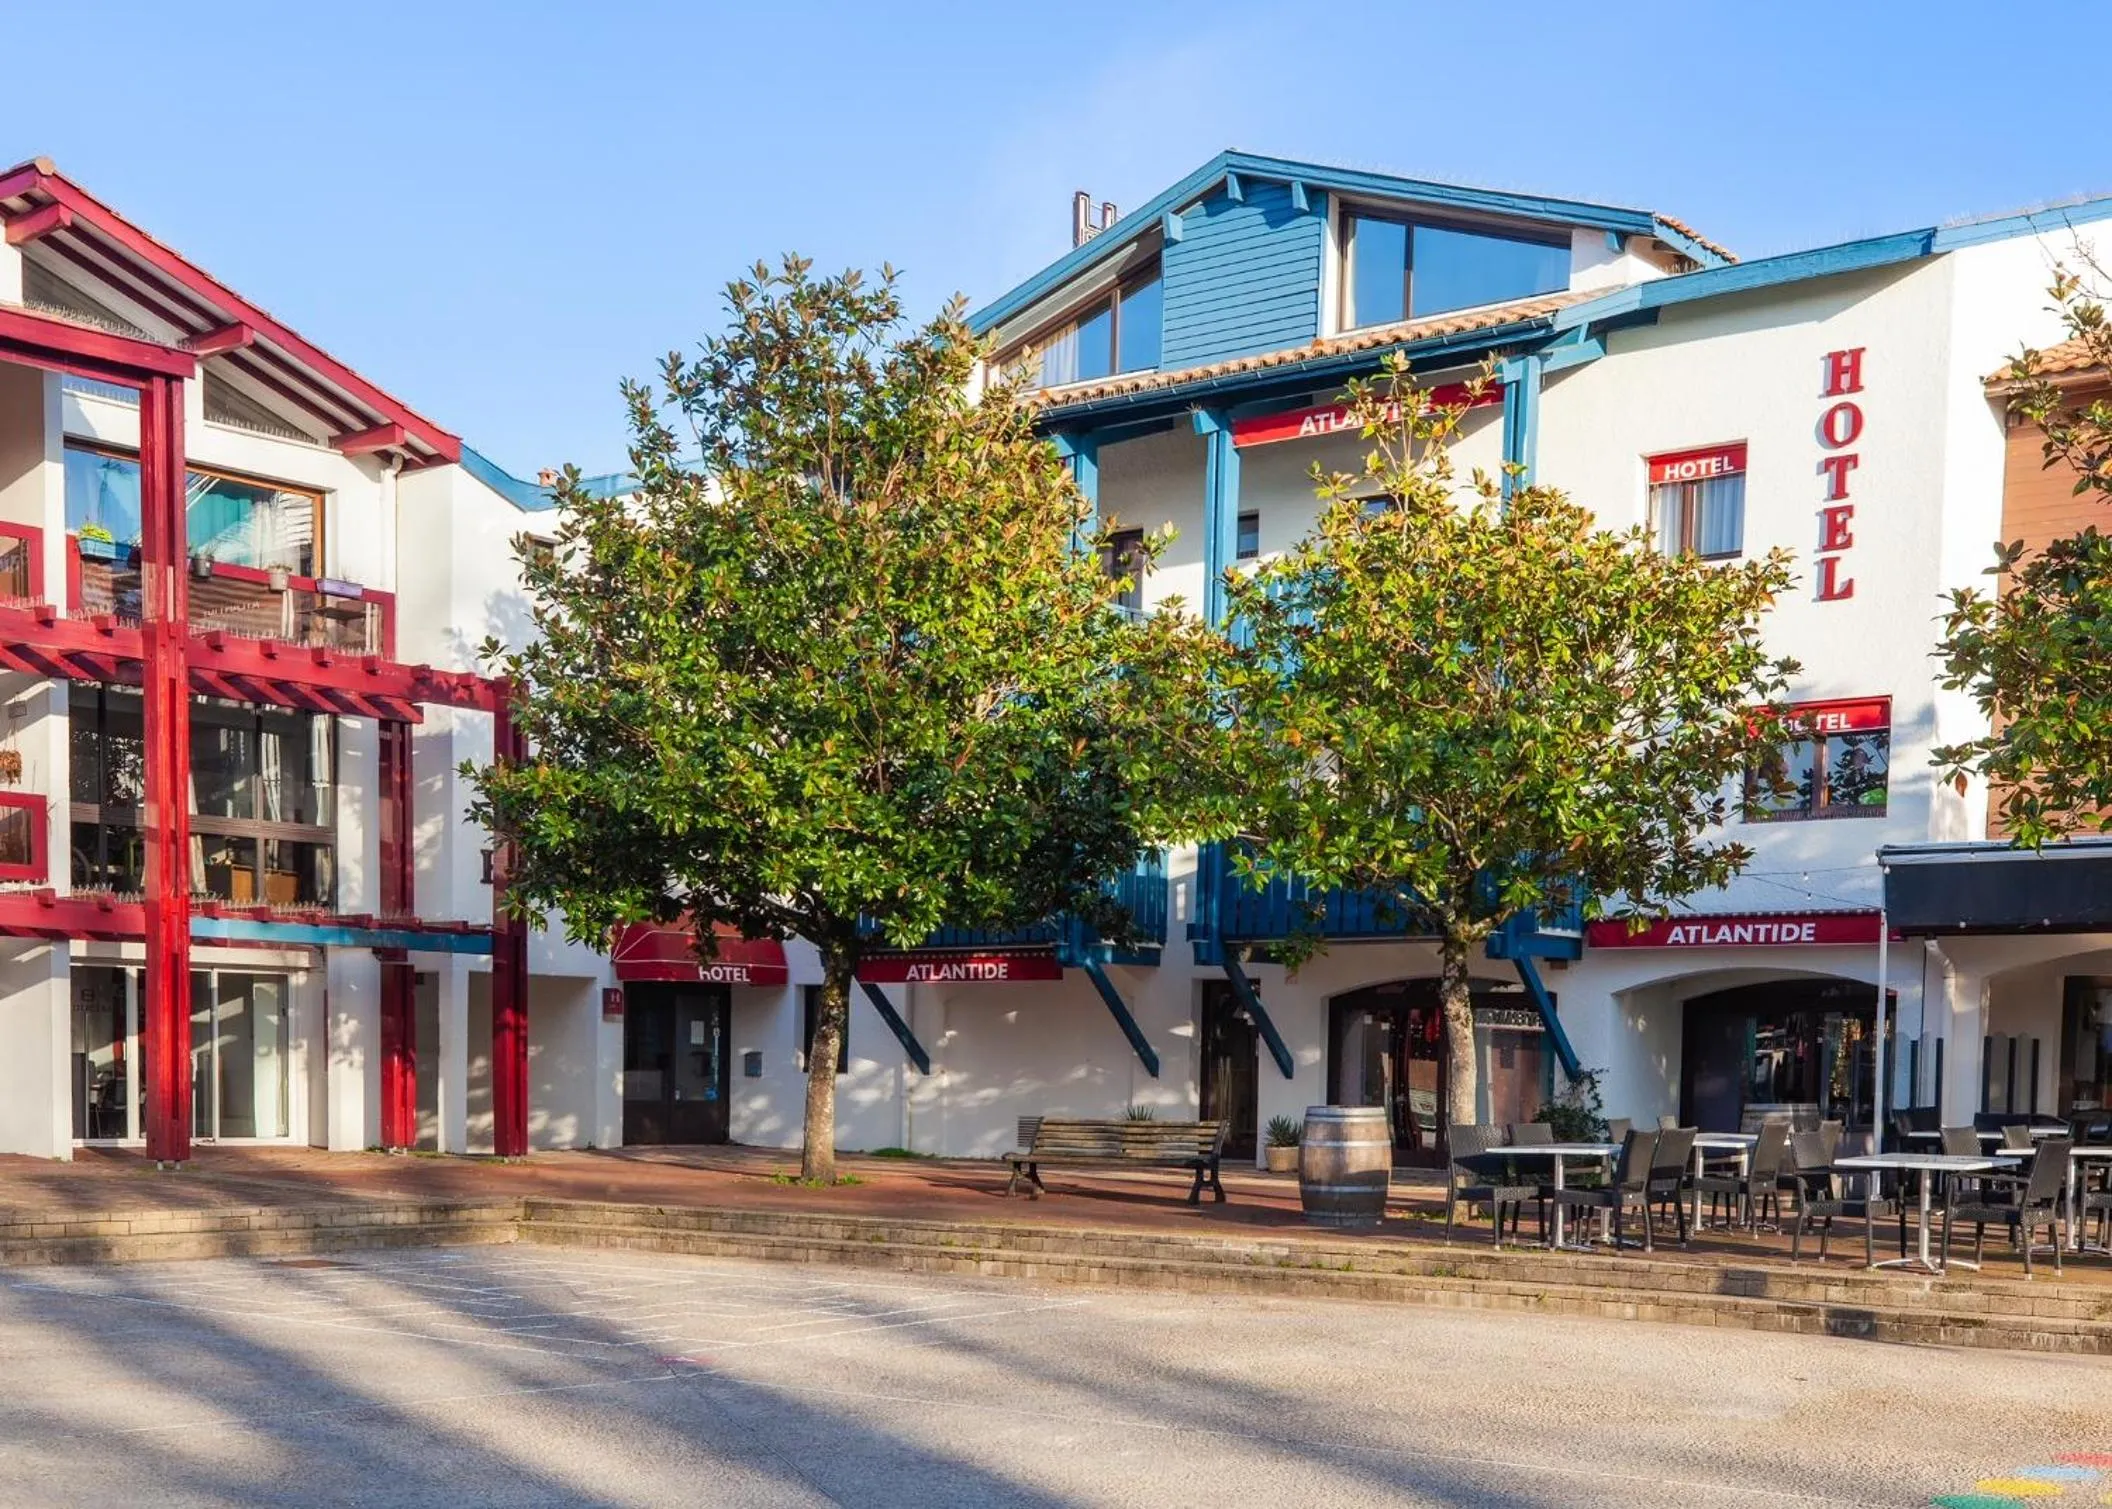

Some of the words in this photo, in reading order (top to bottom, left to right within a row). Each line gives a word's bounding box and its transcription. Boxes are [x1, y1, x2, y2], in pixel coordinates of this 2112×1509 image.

[1664, 456, 1734, 480] HOTEL
[1818, 347, 1866, 600] HOTEL
[1667, 923, 1816, 944] ATLANTIDE
[698, 966, 751, 982] HOTEL
[906, 963, 1009, 981] ATLANTIDE
